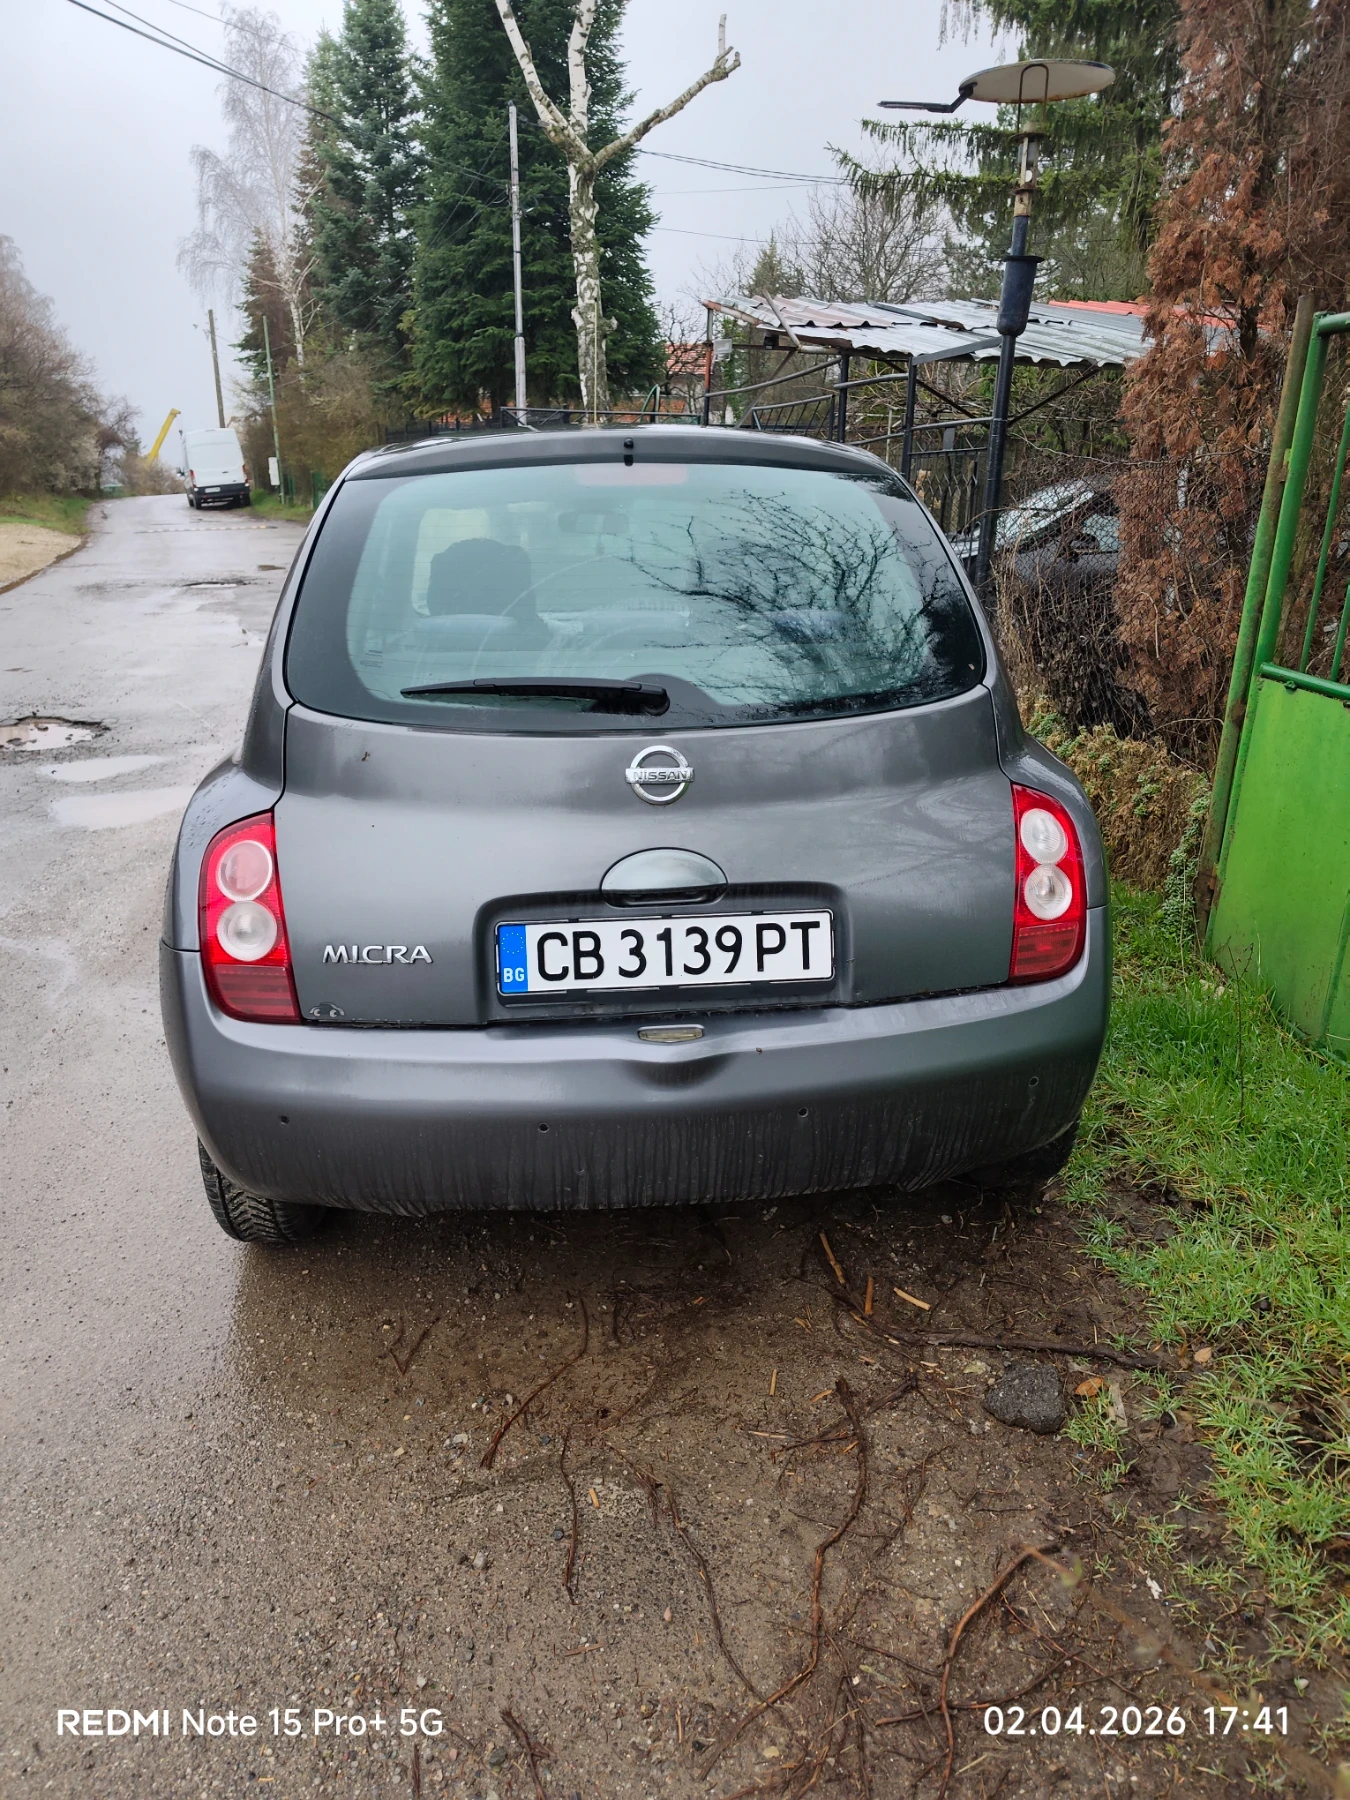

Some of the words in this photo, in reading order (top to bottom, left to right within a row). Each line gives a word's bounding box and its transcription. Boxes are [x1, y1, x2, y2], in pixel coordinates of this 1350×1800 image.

[633, 770, 688, 781] NISSAN
[322, 945, 434, 964] MICRA
[537, 930, 605, 982] CB
[618, 925, 743, 978] 3139
[755, 920, 820, 972] PT
[503, 968, 525, 983] BG
